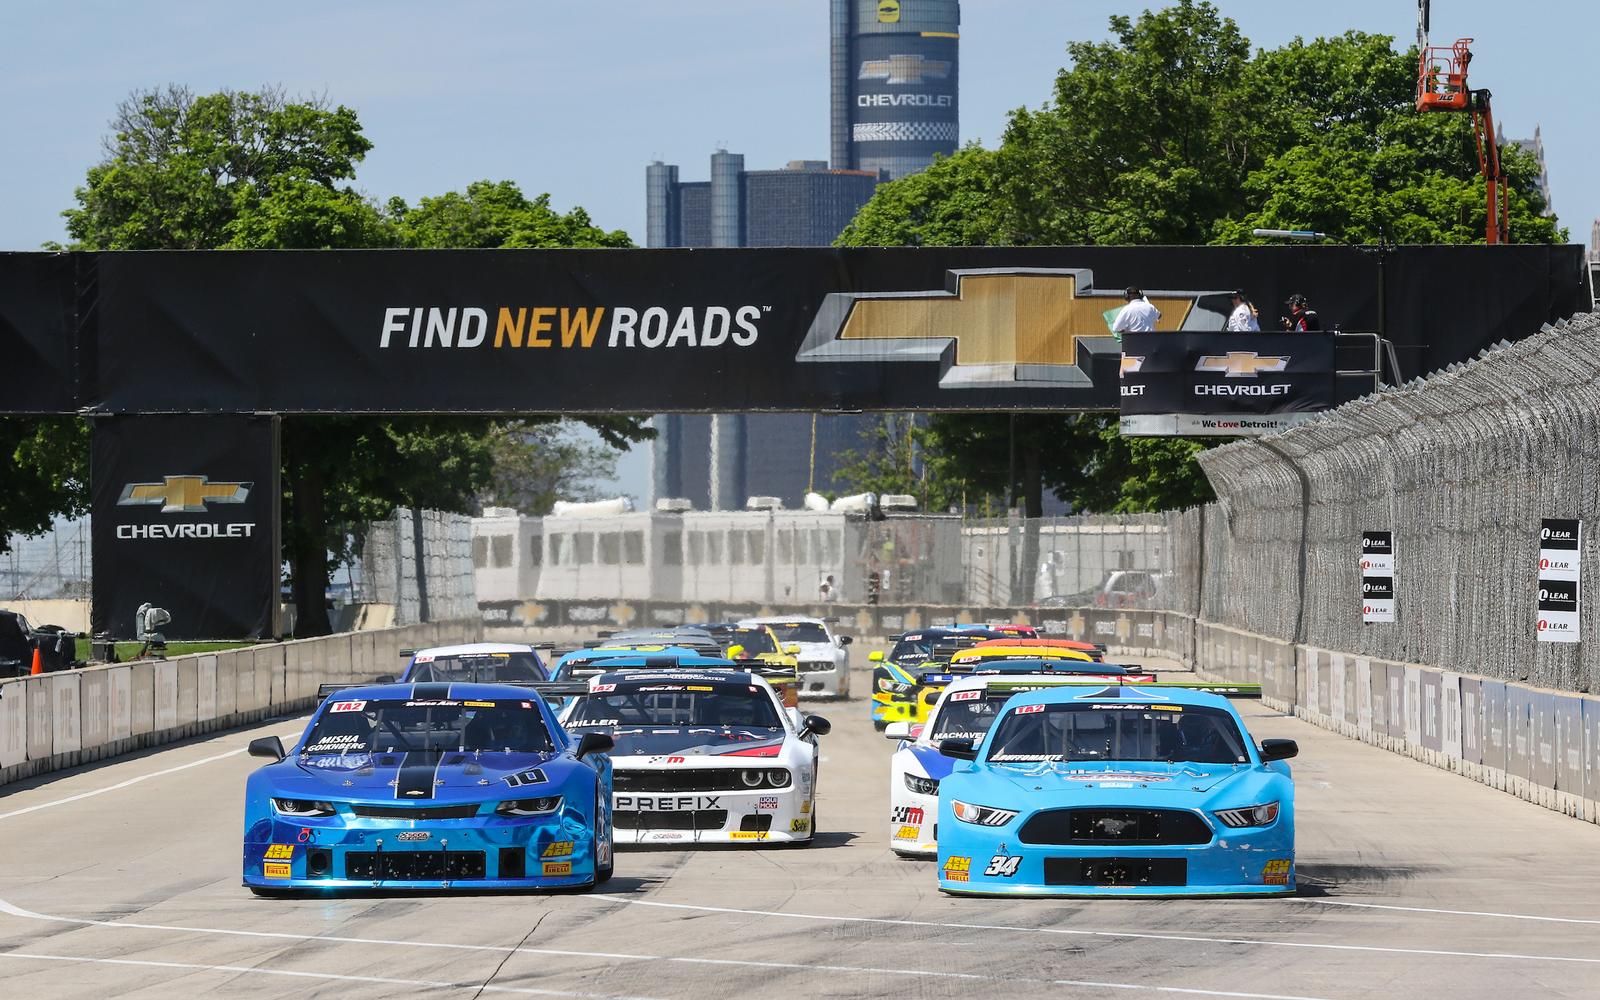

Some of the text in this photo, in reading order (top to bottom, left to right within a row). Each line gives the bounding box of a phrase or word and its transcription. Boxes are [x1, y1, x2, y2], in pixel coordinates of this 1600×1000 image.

[857, 94, 952, 107] CHEVROLET
[380, 308, 488, 348] FIND
[493, 307, 604, 348] NEW
[607, 306, 760, 347] ROADS
[1194, 384, 1291, 396] CHEVROLET
[1201, 420, 1278, 429] We Love Detroit!
[116, 523, 256, 539] CHEVROLET
[336, 703, 361, 711] TA2
[1018, 705, 1043, 713] TA2
[566, 719, 618, 729] MILLER
[318, 735, 360, 744] MISHA
[307, 742, 367, 752] GOIKHBERG
[500, 768, 549, 788] 10
[616, 796, 720, 810] PREFIX
[263, 844, 295, 858] AEM
[942, 856, 971, 871] AEM
[984, 855, 1023, 877] 34
